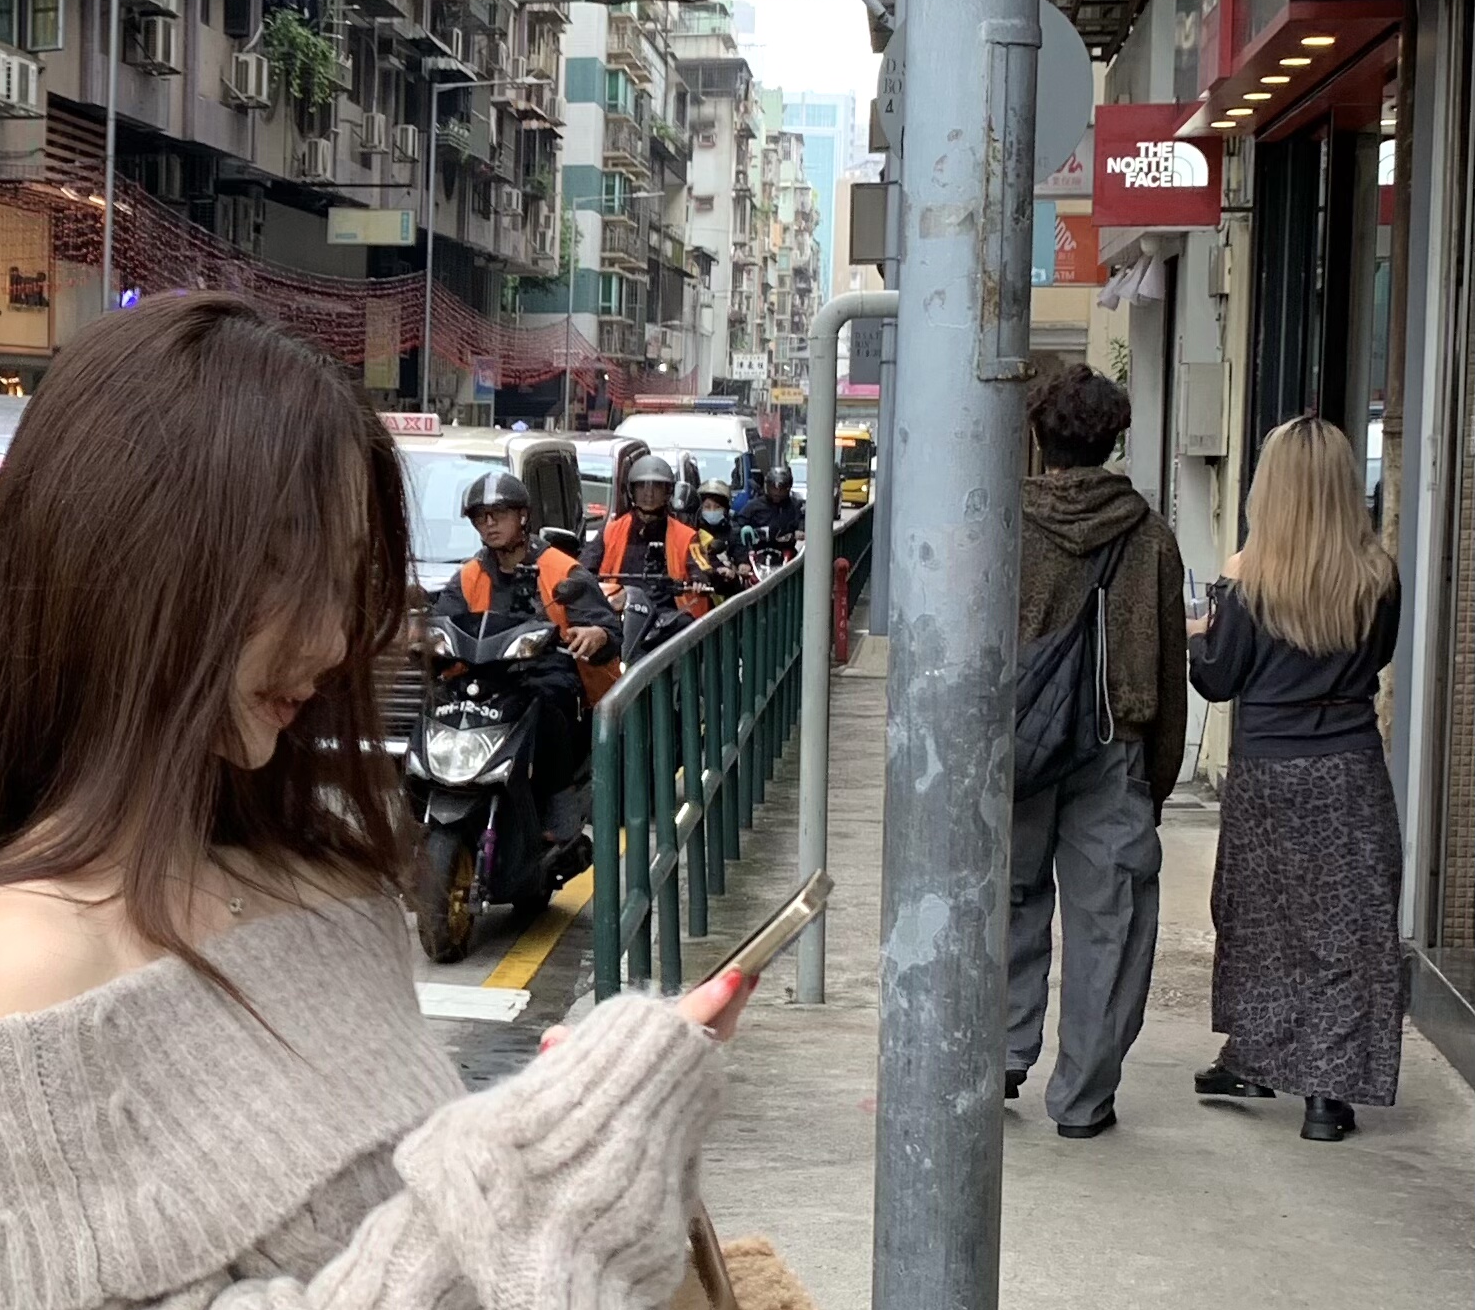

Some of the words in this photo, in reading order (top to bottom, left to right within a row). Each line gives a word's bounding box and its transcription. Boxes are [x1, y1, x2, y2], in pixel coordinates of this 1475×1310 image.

[1136, 141, 1174, 158] THE
[1107, 157, 1174, 174] NORTH
[1125, 172, 1174, 188] FACE
[385, 416, 433, 431] AXI
